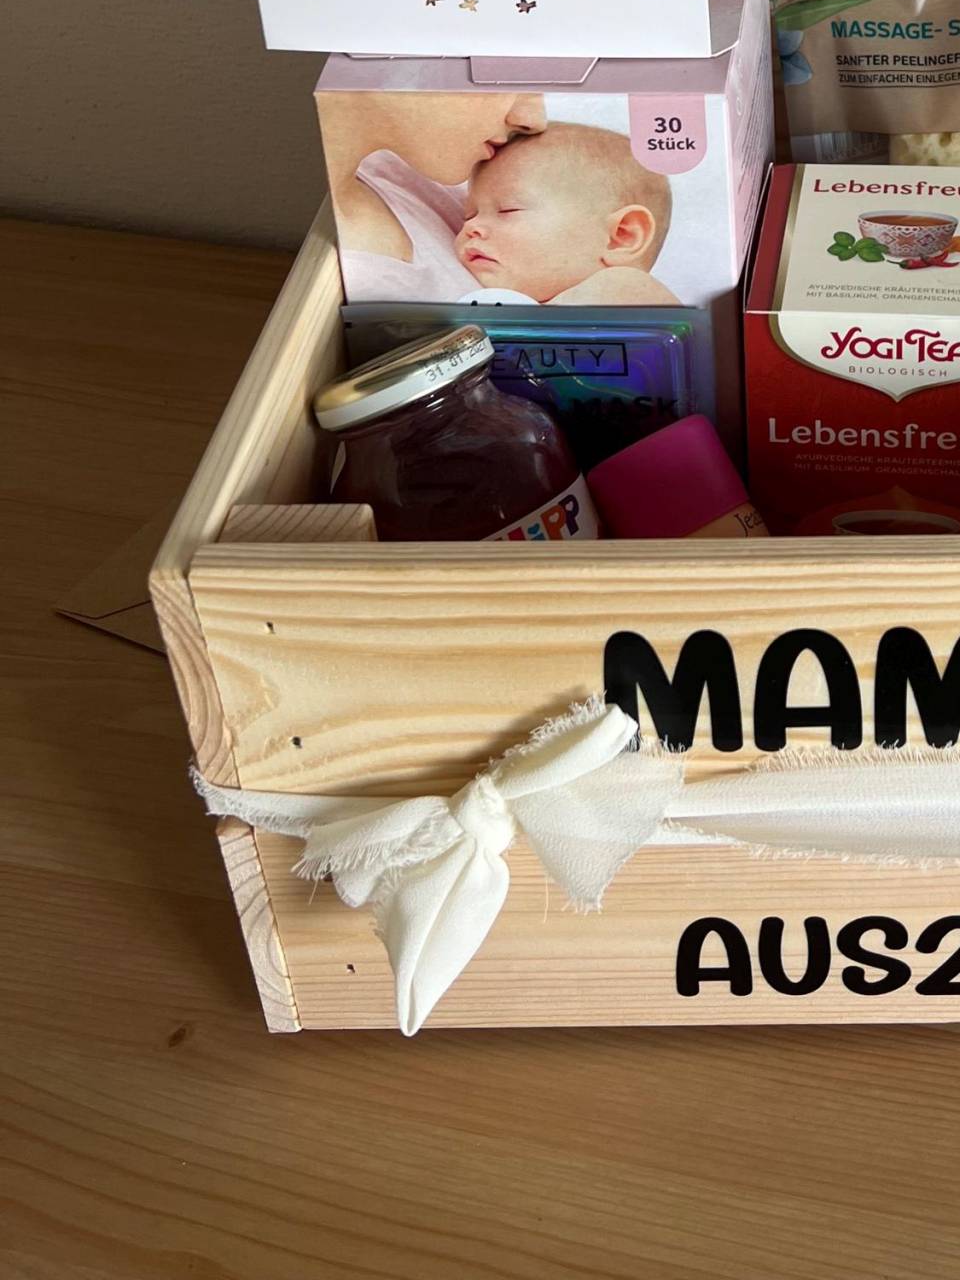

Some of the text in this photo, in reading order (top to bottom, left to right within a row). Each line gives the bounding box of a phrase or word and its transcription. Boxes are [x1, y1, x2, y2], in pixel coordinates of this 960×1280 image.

[830, 20, 943, 40] MASSAGE-
[835, 54, 889, 67] SANFTER
[838, 73, 857, 84] ZUM
[858, 73, 914, 84] EINFACHEN
[654, 116, 682, 134] 30
[647, 137, 696, 151] Stück
[820, 326, 904, 360] YOGI
[491, 346, 607, 372] EAUTY
[848, 365, 948, 377] BIOLOGISCH
[733, 510, 763, 538] Jea
